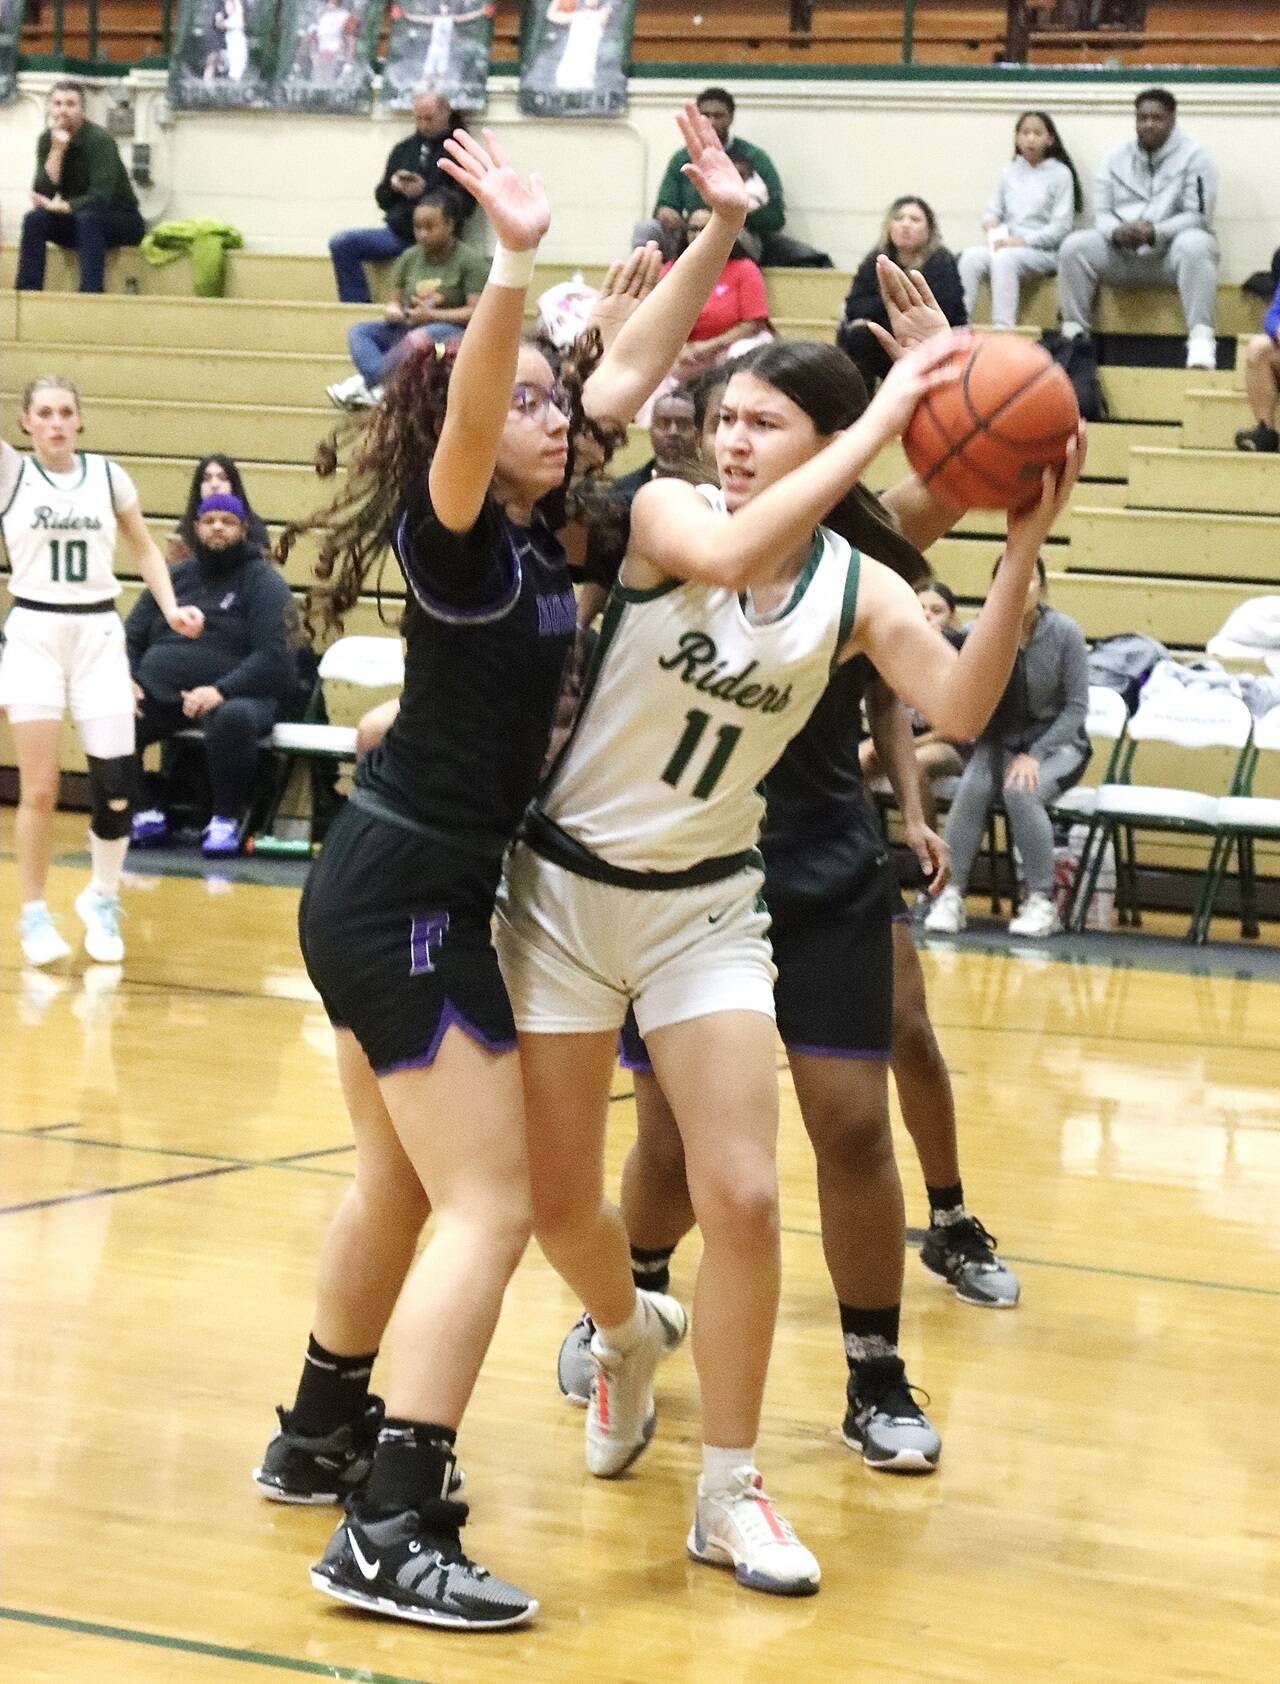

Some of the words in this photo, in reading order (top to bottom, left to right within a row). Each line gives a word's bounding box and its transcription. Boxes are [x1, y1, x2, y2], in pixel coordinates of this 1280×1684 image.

[31, 506, 103, 532] Riders
[49, 540, 88, 583] 10
[658, 630, 793, 715] Riders
[661, 707, 744, 801] 11
[409, 909, 451, 977] F
